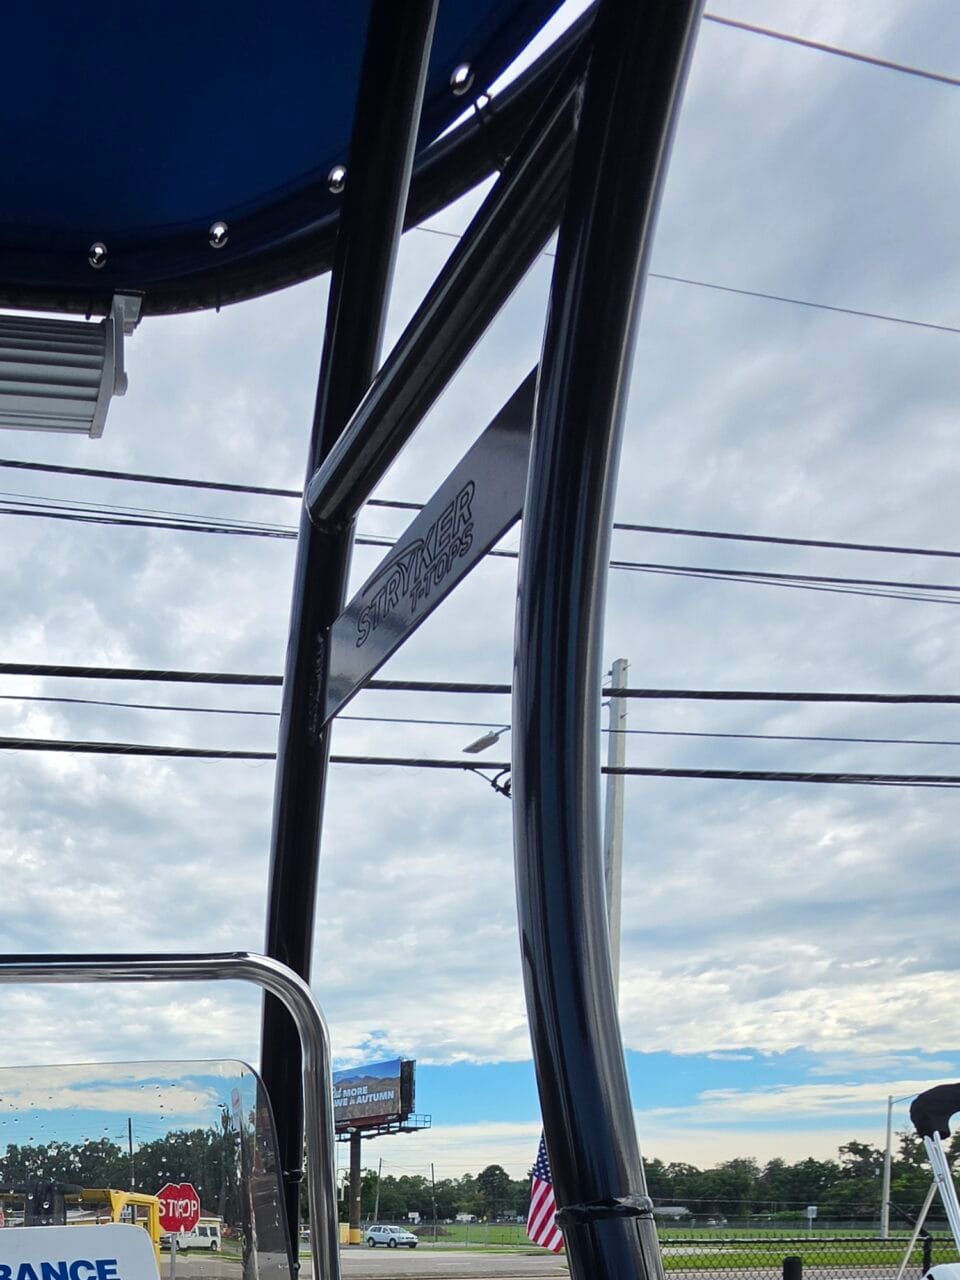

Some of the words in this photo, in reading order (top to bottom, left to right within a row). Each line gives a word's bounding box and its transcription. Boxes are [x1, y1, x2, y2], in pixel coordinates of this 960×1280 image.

[356, 480, 476, 648] STRYKER
[410, 522, 474, 615] T-TOPS
[333, 1098, 348, 1107] WE
[356, 1090, 394, 1104] AUTUMN
[343, 1086, 368, 1098] MORE
[159, 1199, 198, 1218] STOP
